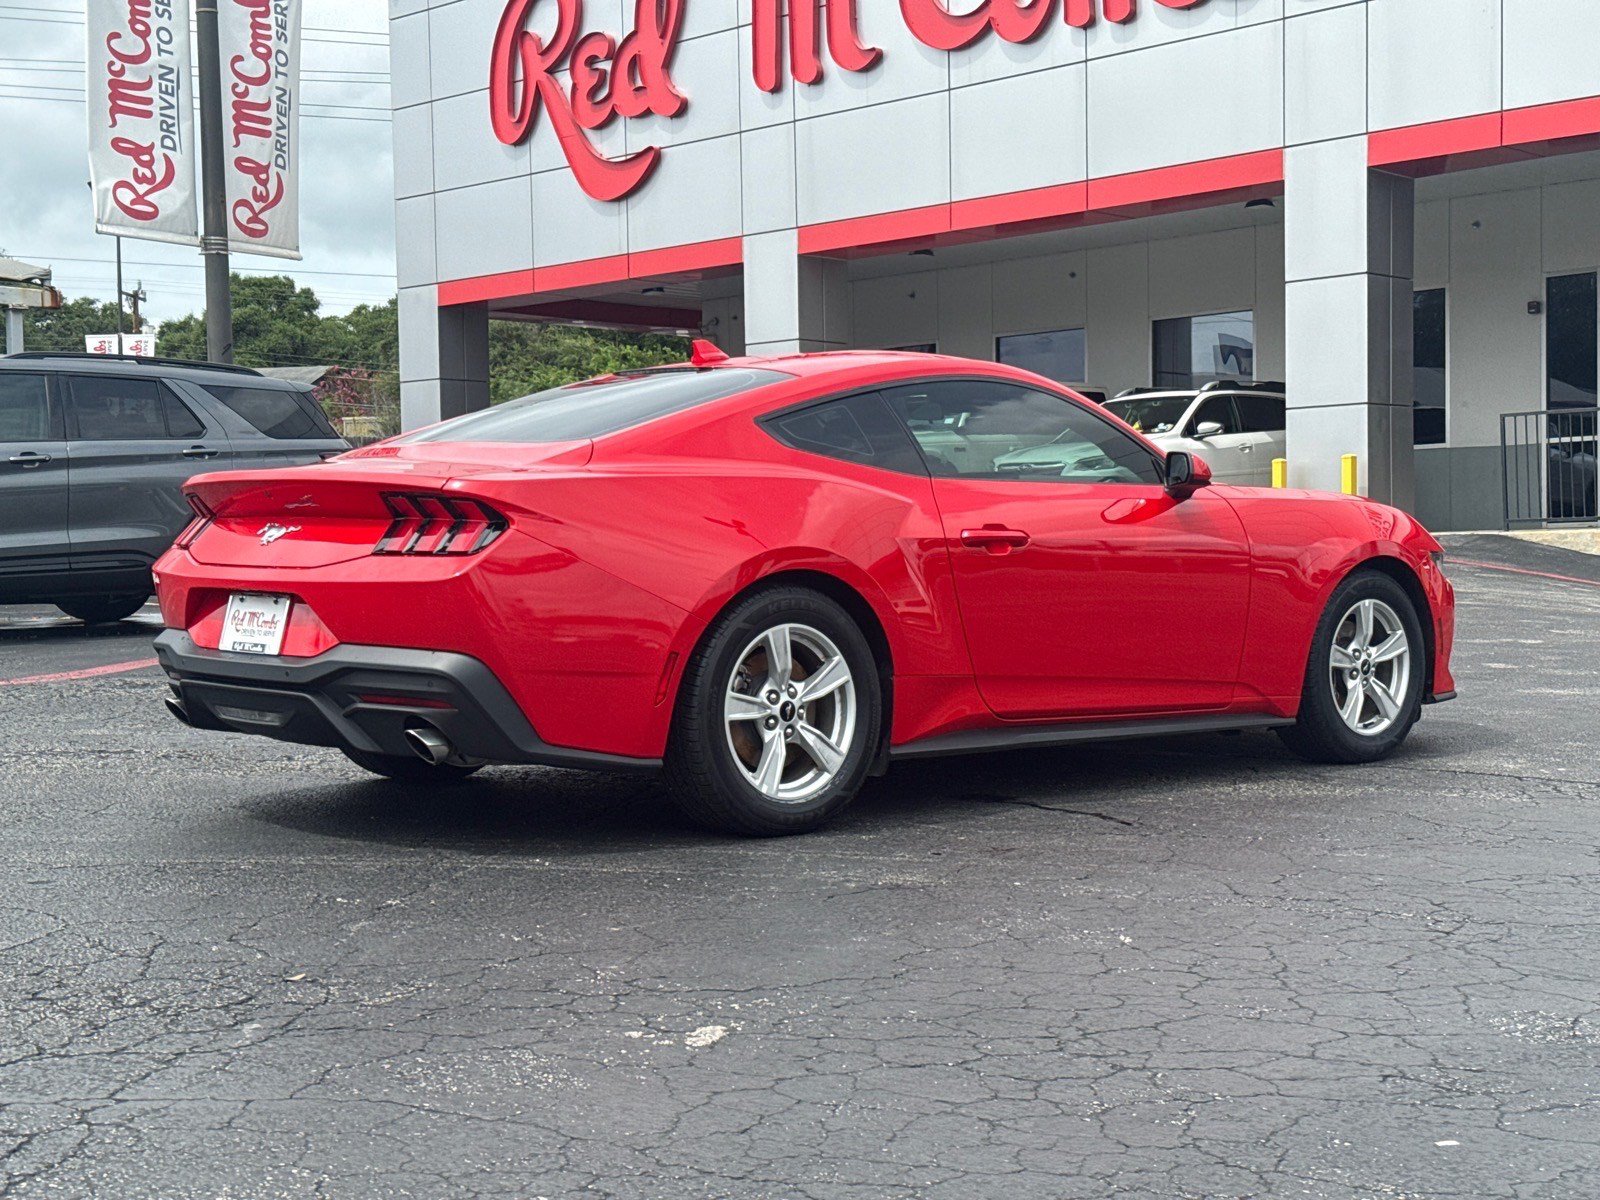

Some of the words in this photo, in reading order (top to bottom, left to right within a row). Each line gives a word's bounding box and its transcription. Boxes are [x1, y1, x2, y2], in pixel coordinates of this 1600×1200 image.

[156, 26, 174, 57] TO
[274, 0, 288, 44] SER
[275, 49, 289, 78] TO
[157, 64, 177, 152] DRIVEN
[230, 0, 273, 148] McCom
[490, 0, 688, 201] Red
[274, 86, 288, 170] DRIVEN
[110, 136, 176, 221] Red
[232, 156, 284, 239] Red
[231, 609, 247, 632] Red
